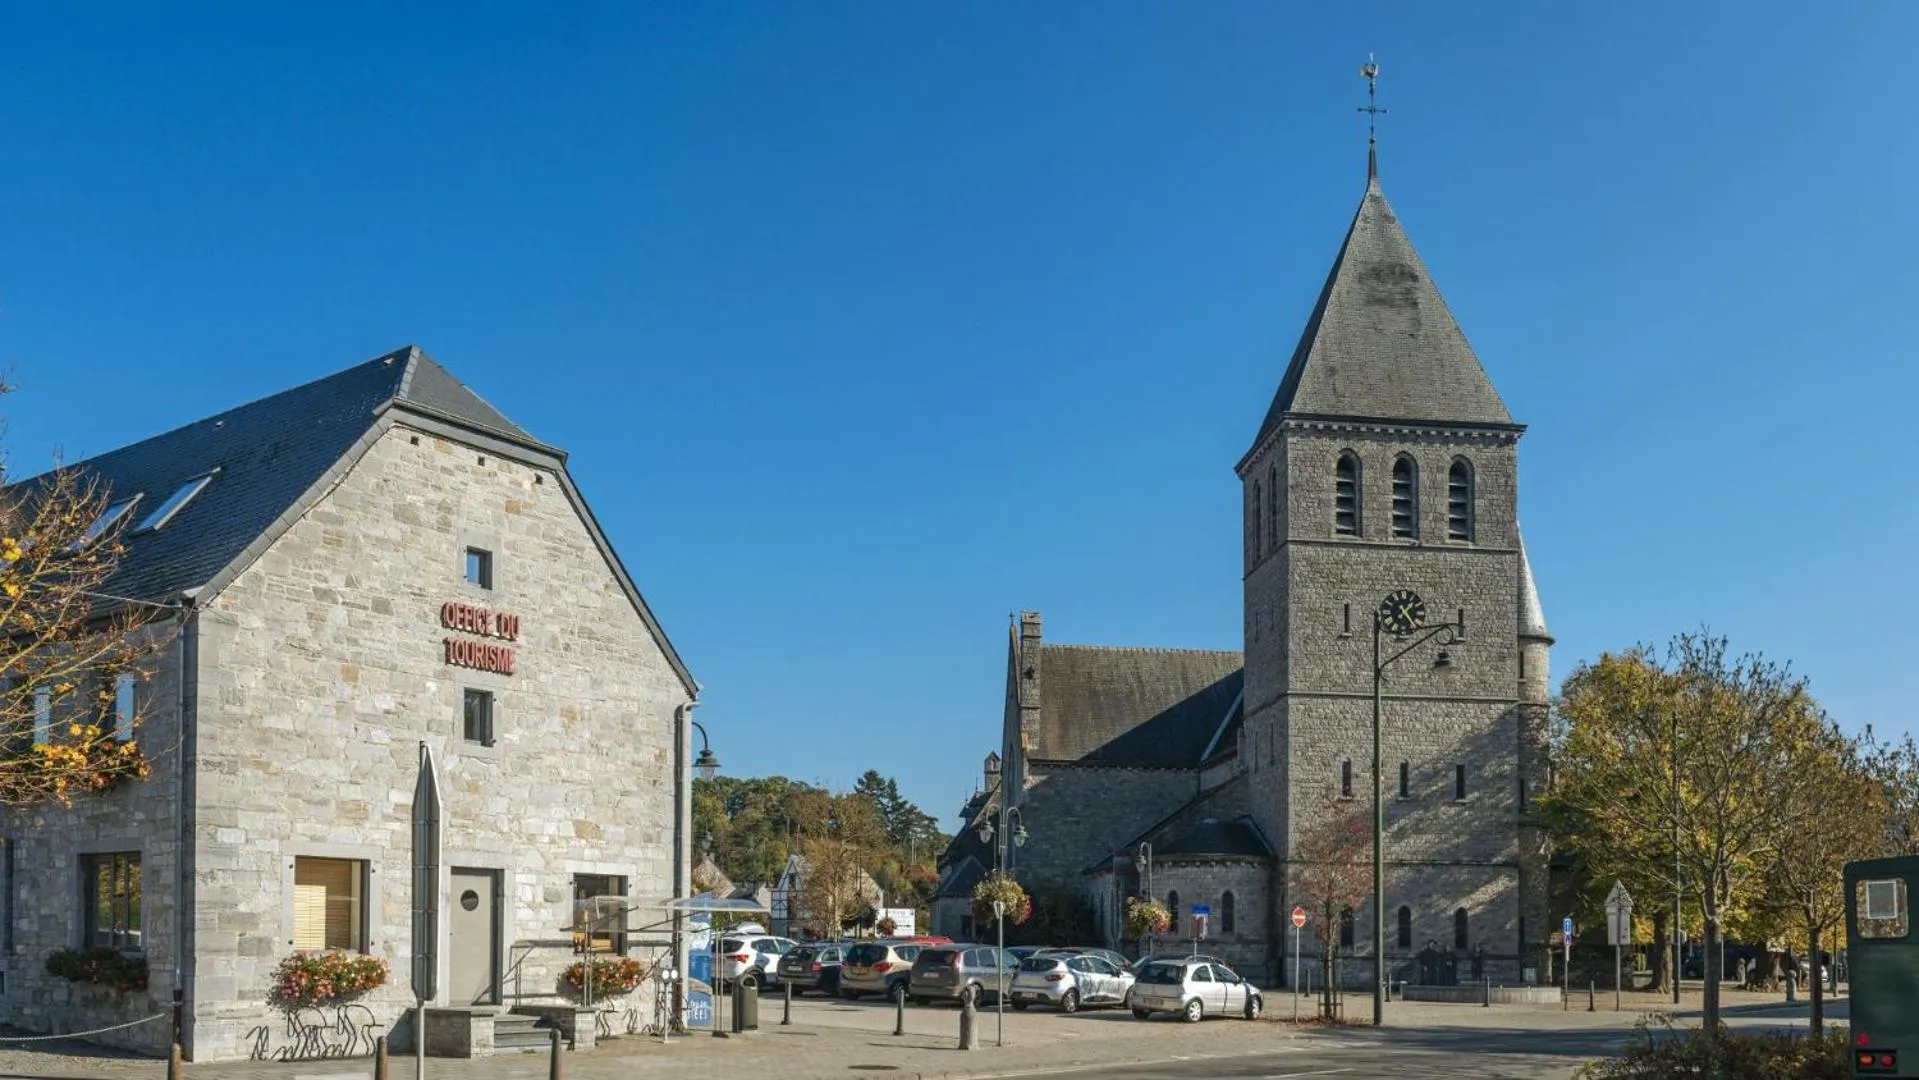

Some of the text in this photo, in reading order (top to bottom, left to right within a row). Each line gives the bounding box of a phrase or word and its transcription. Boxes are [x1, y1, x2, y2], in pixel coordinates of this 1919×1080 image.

[441, 602, 522, 639] OFFICE DU
[444, 637, 515, 674] TOURISME
